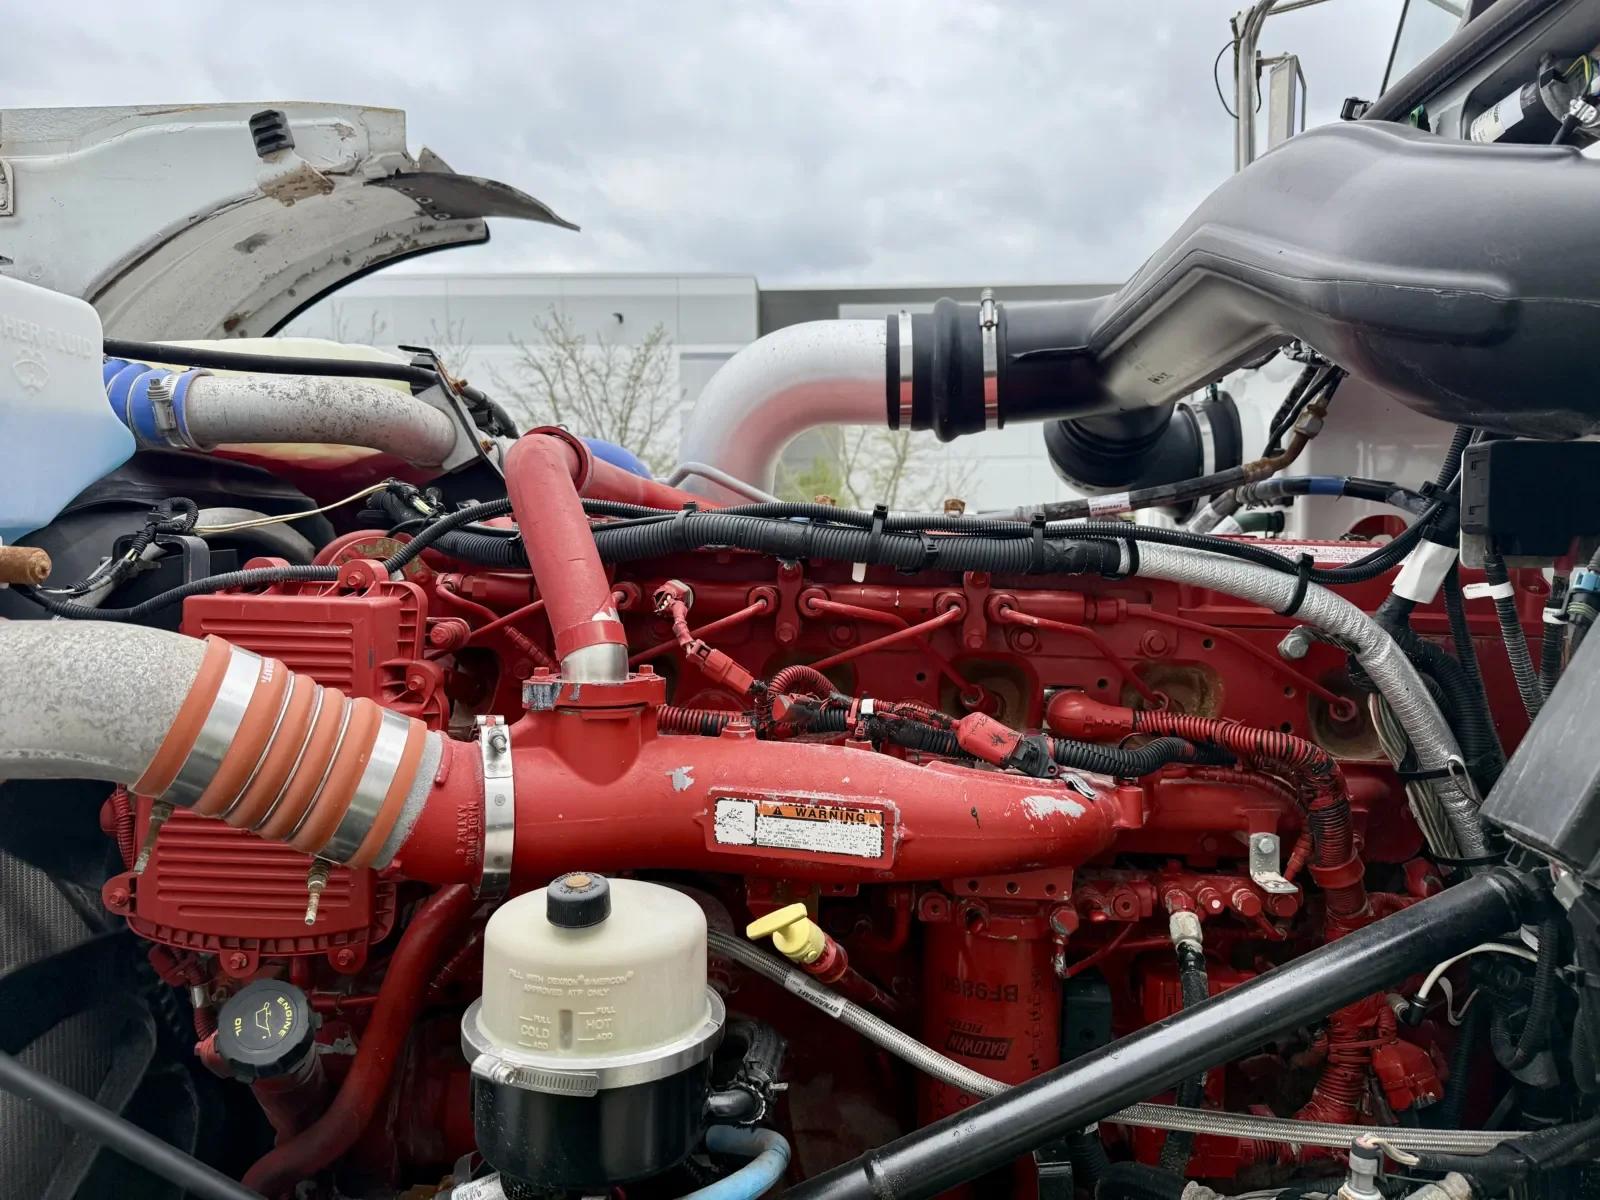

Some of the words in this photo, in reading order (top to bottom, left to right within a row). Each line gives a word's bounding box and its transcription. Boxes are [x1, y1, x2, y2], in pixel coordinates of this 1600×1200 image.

[47, 327, 93, 359] FLUID
[795, 807, 866, 823] WARNING
[277, 997, 293, 1037] ENGINE
[596, 1005, 616, 1015] FULL
[234, 1018, 243, 1037] OIL
[533, 1015, 552, 1025] FULL
[585, 1018, 612, 1031] HOT
[520, 1024, 550, 1039] COLD
[596, 1031, 613, 1041] ADD
[532, 1040, 549, 1050] ADD
[948, 1033, 1009, 1057] BALDWIN
